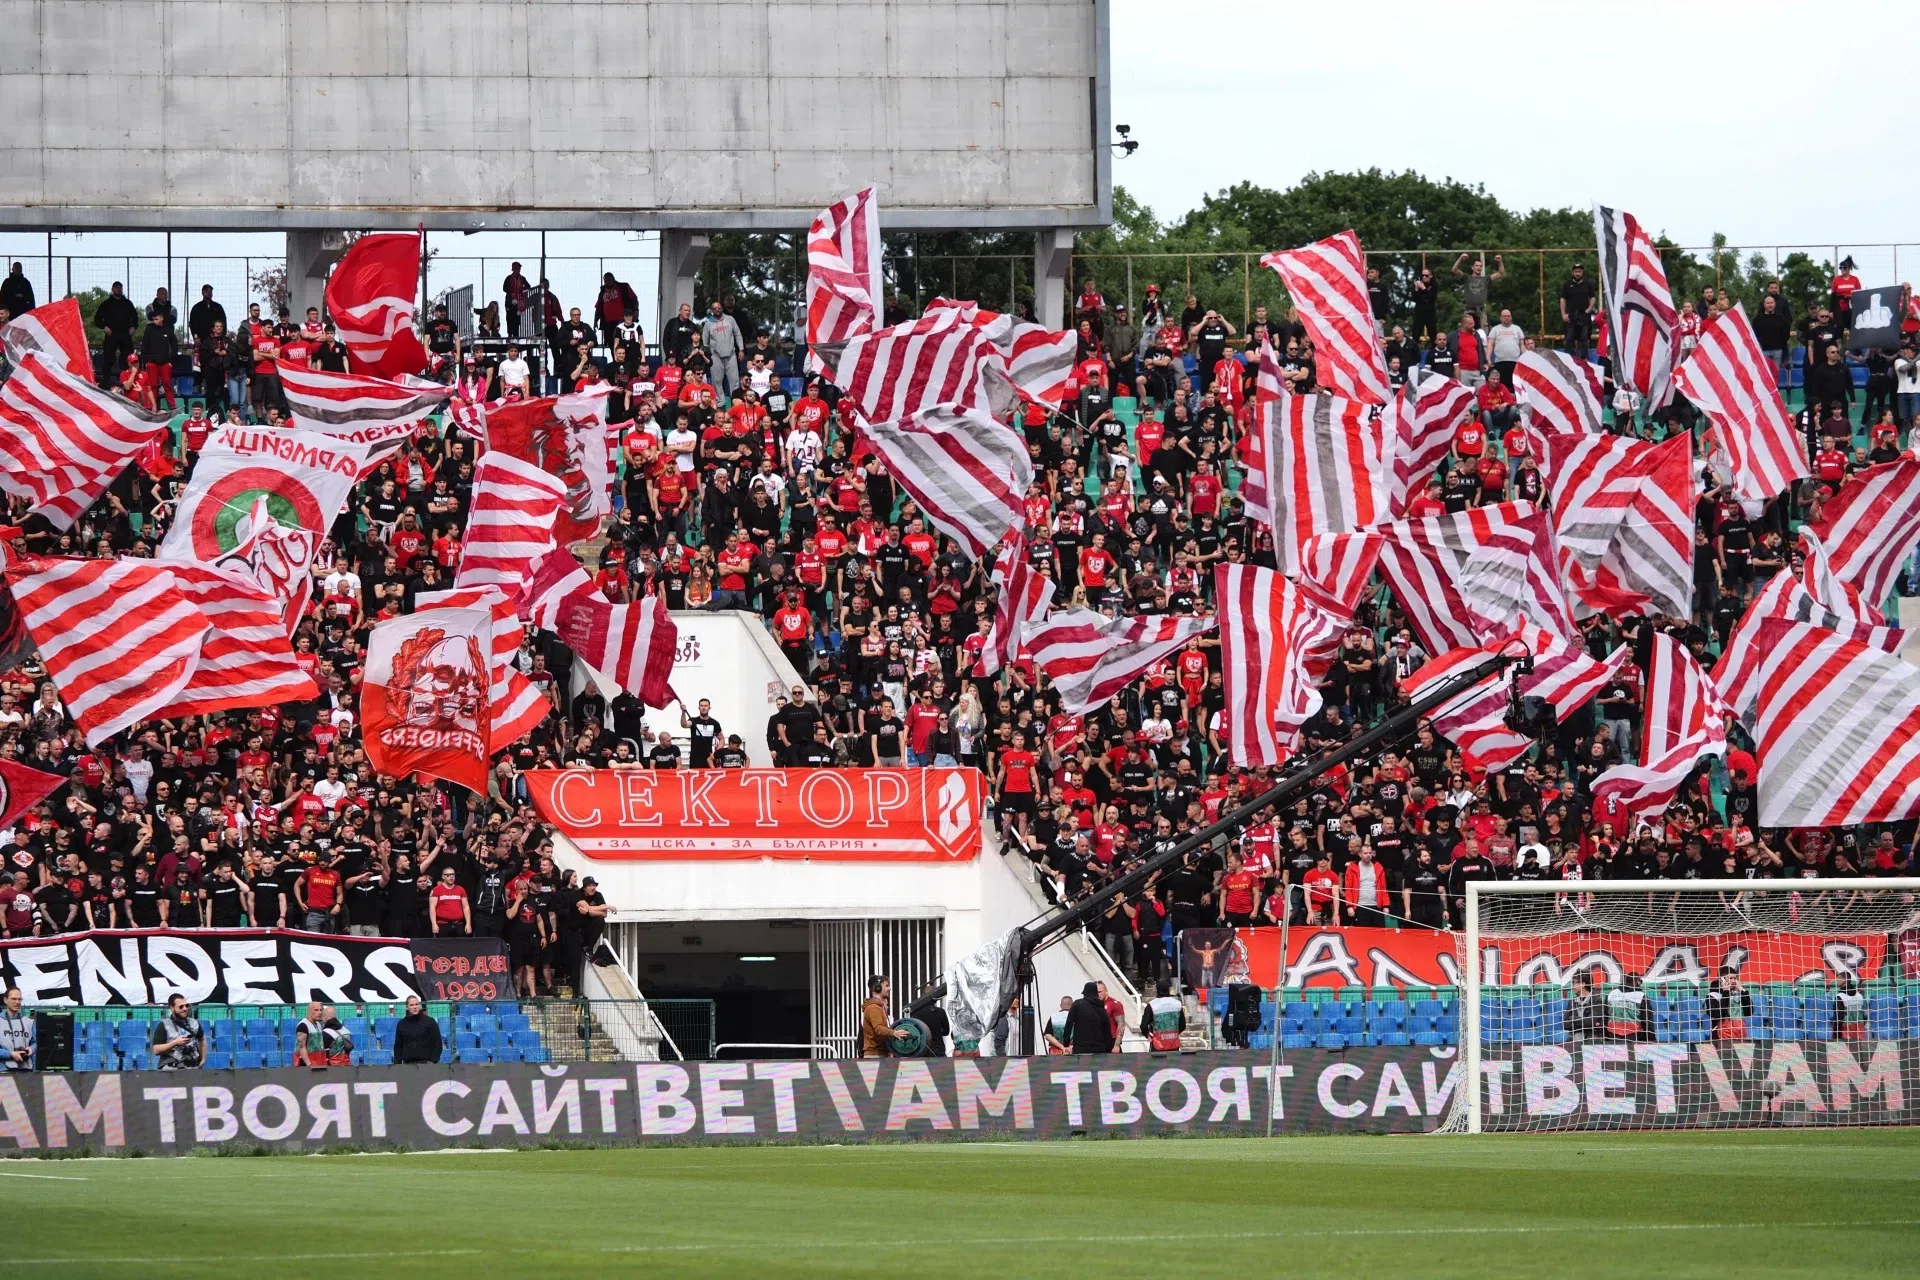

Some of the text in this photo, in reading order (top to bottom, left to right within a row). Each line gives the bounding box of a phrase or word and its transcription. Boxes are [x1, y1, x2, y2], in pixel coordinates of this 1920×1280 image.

[550, 768, 909, 828] СЕКТОР
[609, 838, 864, 851] ЗА ЦСКА ЗА БЪЛГАРИЯ
[0, 938, 421, 1006] ENDERS
[435, 981, 497, 1000] 1999
[3, 1030, 29, 1038] PHOTO
[143, 1081, 398, 1143] ТВОЯТ
[421, 1064, 628, 1137] САЙТ
[1051, 1065, 1293, 1126] ТВОЯТ
[1317, 1046, 1513, 1120] САЙТ
